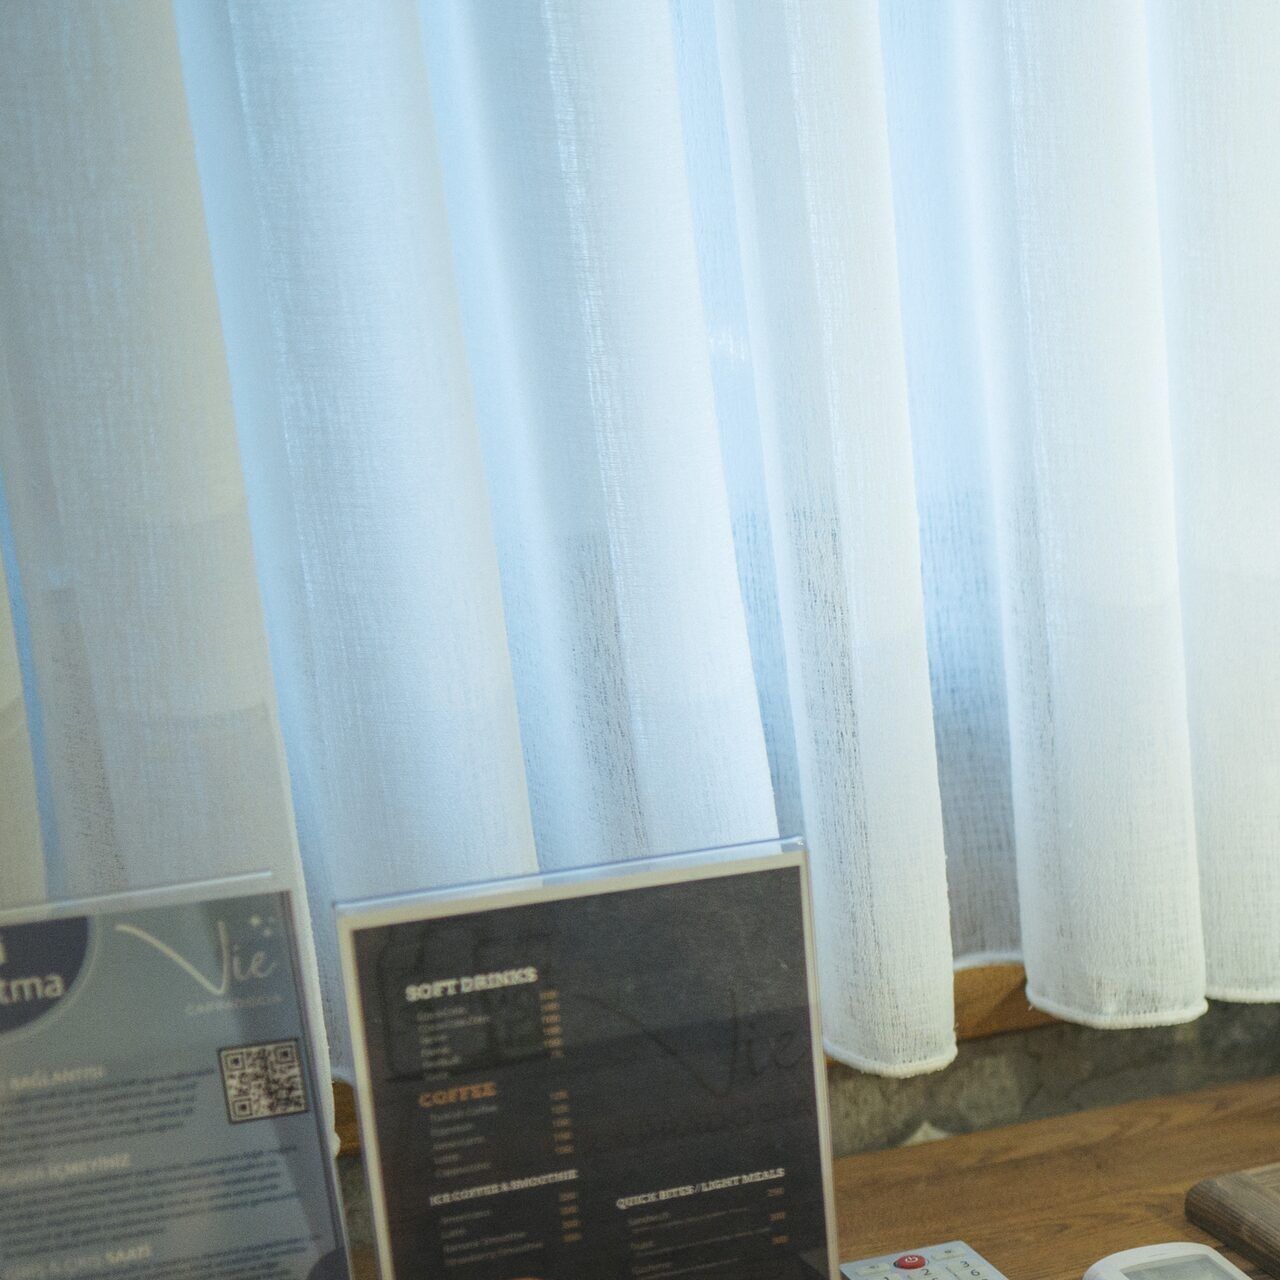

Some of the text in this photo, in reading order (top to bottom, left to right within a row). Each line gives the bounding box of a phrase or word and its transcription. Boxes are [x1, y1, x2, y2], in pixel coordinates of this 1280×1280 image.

[405, 967, 538, 1002] SOFT DRINKS
[419, 1082, 497, 1107] COFFEE
[616, 1192, 657, 1211] QUICK
[700, 1175, 740, 1192] LIGHT
[741, 1168, 785, 1185] MEALS
[960, 1260, 970, 1268] 3
[971, 1269, 980, 1277] 6
